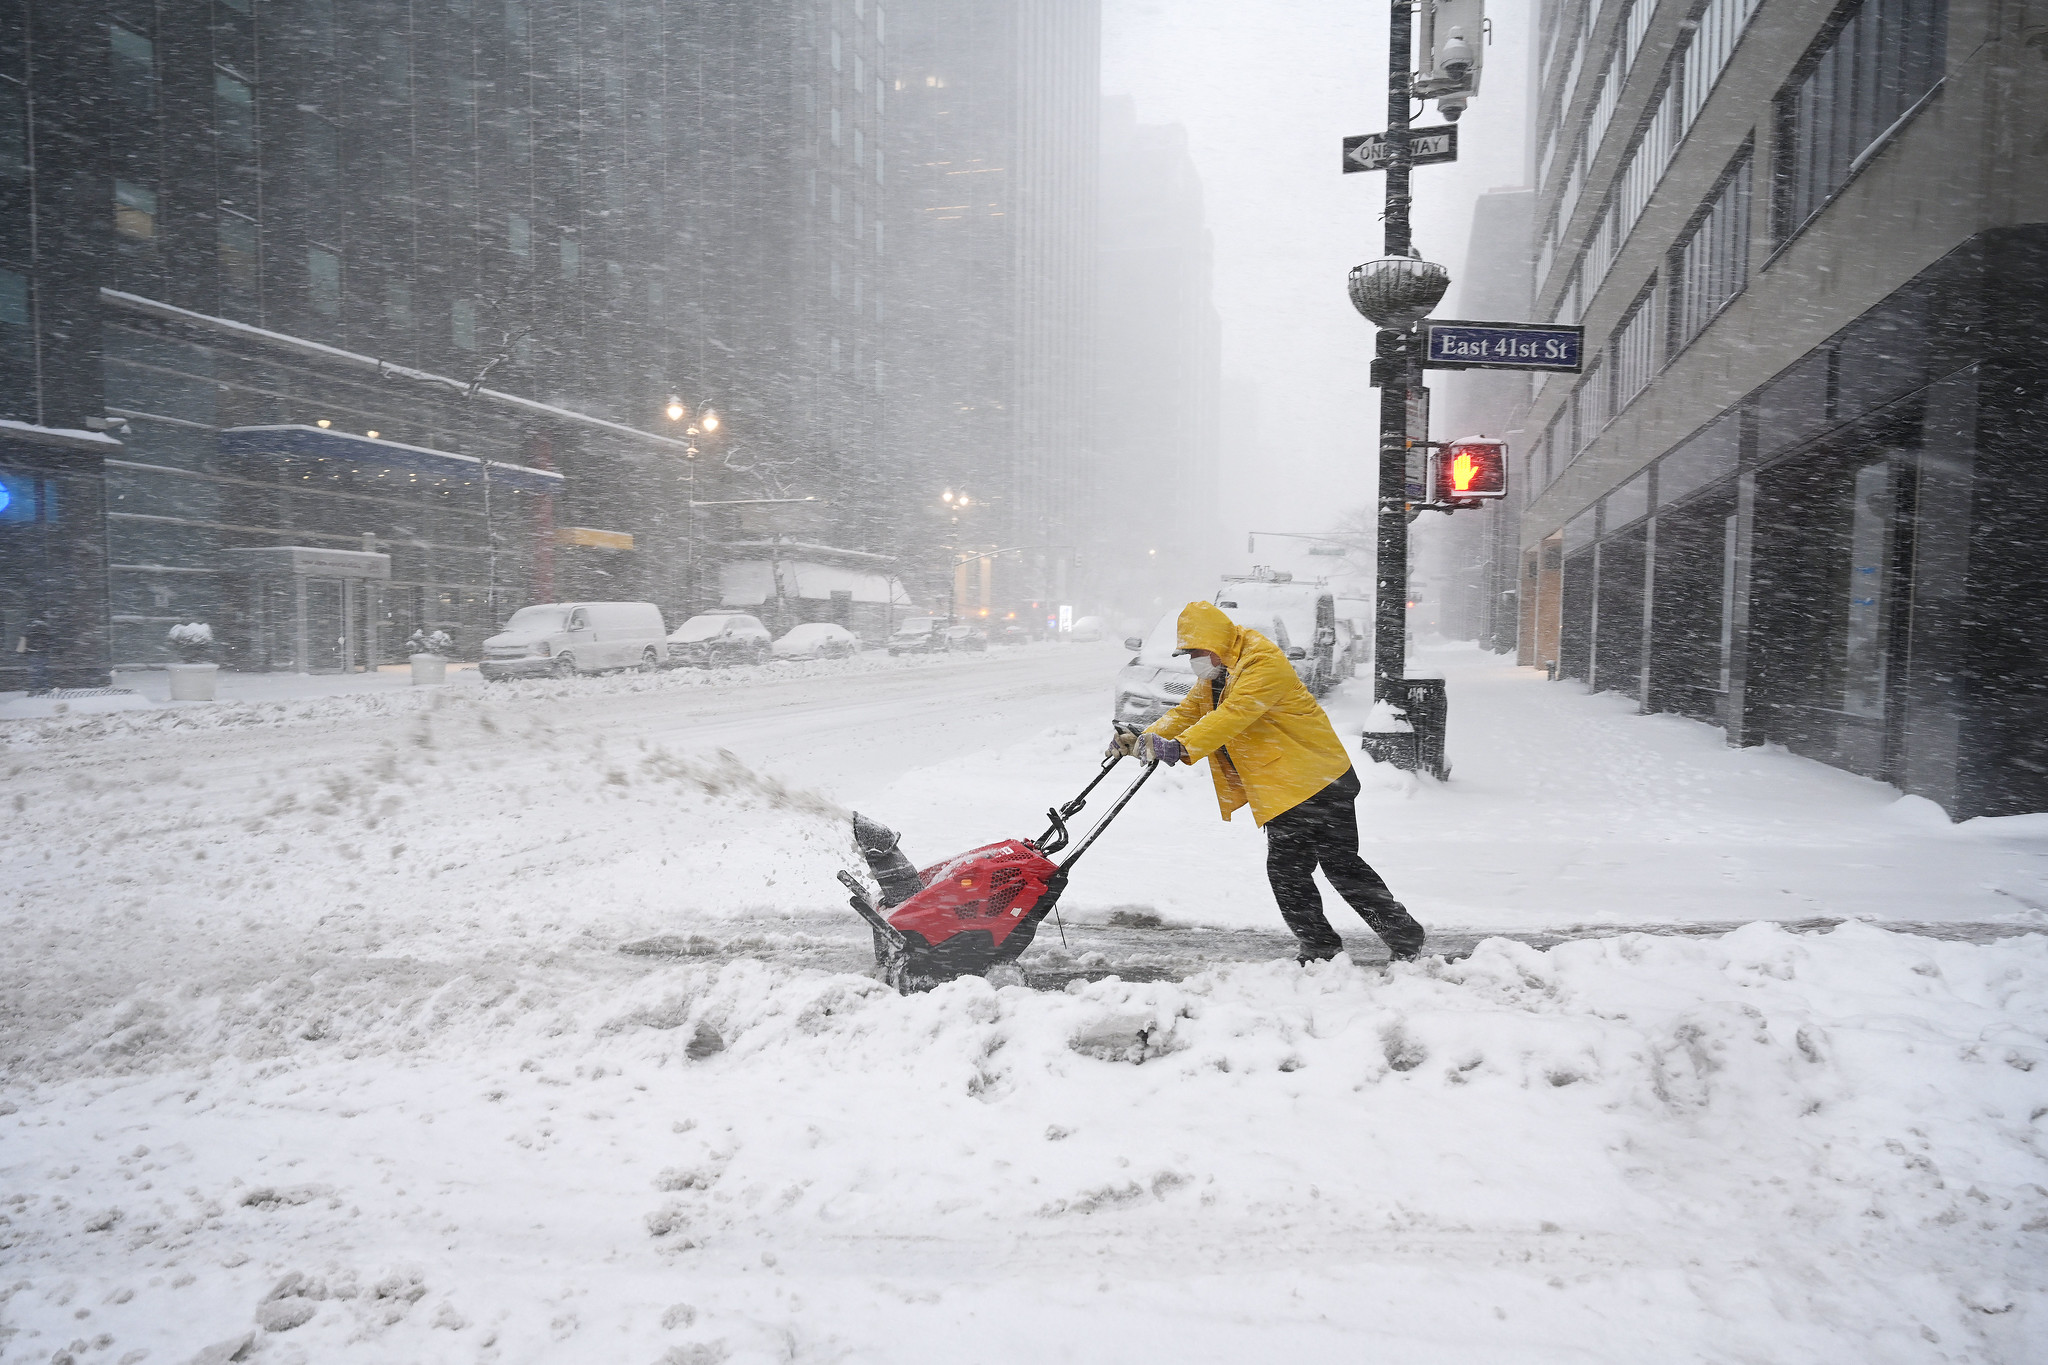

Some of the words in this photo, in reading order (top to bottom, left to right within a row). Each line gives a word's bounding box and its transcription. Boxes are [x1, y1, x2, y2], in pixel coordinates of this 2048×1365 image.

[1441, 335, 1489, 356] East
[1494, 337, 1539, 358] 41st
[1545, 338, 1569, 359] St
